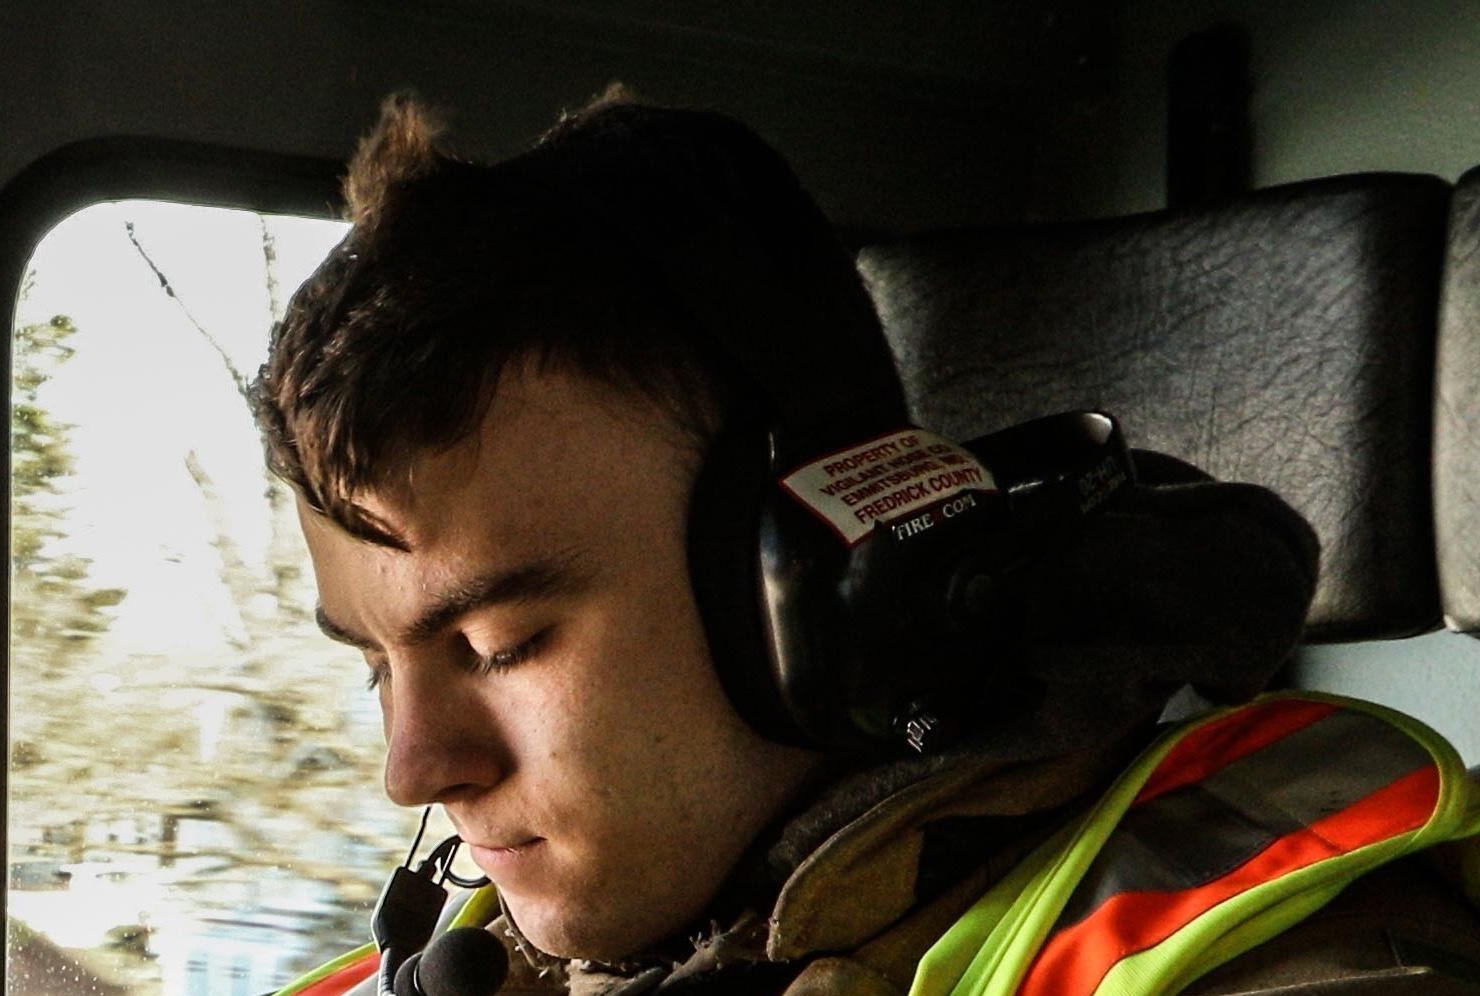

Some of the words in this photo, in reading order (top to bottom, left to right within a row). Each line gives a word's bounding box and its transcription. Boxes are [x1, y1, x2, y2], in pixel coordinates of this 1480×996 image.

[823, 441, 901, 477] PROPERTY
[900, 434, 919, 449] OF
[819, 464, 890, 496] VIGILANT
[854, 482, 931, 524] FREDRICK
[928, 466, 983, 491] COUNTY
[896, 512, 936, 541] FIRE
